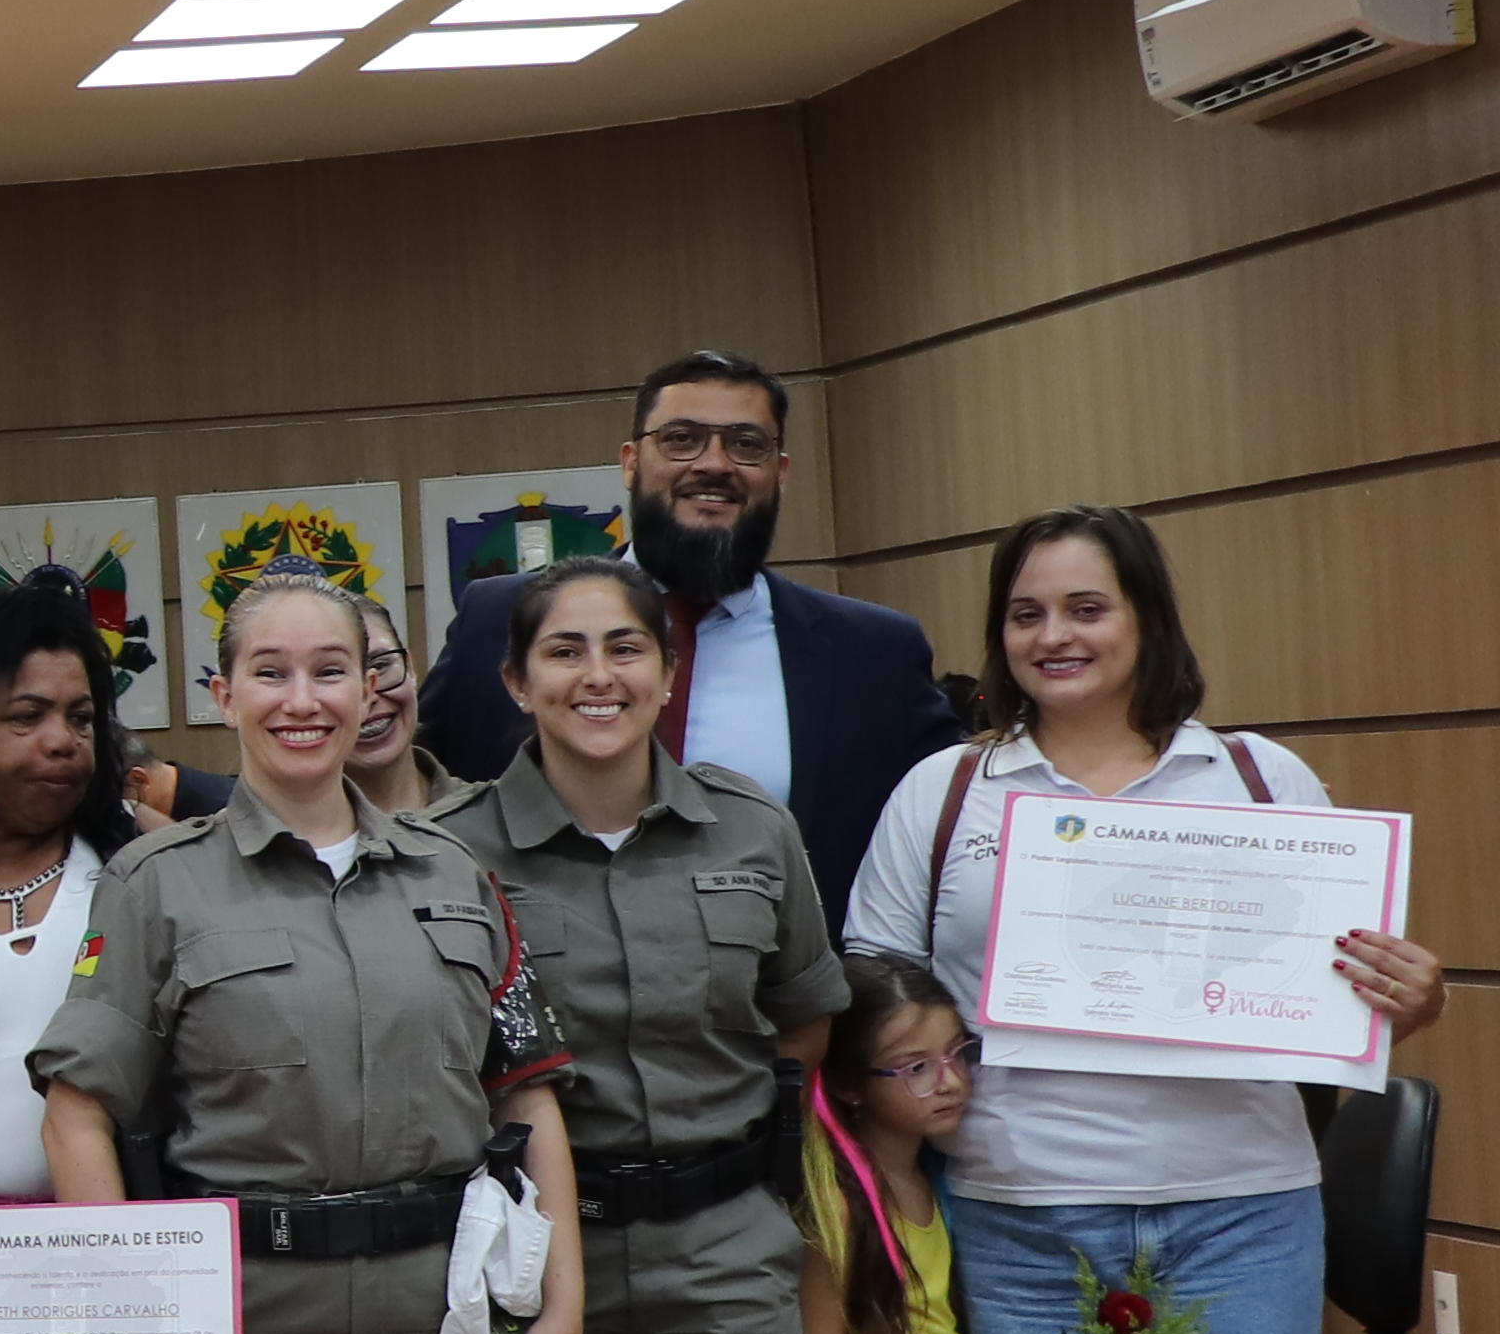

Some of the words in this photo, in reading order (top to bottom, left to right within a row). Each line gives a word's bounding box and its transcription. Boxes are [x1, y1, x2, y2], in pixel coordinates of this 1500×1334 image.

[965, 832, 1000, 849] POL
[1092, 822, 1171, 843] CÂMARA
[1174, 831, 1270, 850] MUNICIPAL
[1273, 838, 1296, 852] DE
[1300, 839, 1357, 857] ESTEIO
[974, 846, 1000, 860] CIV
[1112, 891, 1179, 907] LUCIANE
[1181, 897, 1264, 914] BERTOLETTI
[1228, 995, 1314, 1023] Mulher
[47, 1232, 128, 1248] MUNICIPAL
[132, 1231, 151, 1246] DE
[156, 1230, 204, 1245] ESTEIO
[22, 1304, 98, 1317] RODRIGUES
[101, 1302, 179, 1316] CARVALHO
